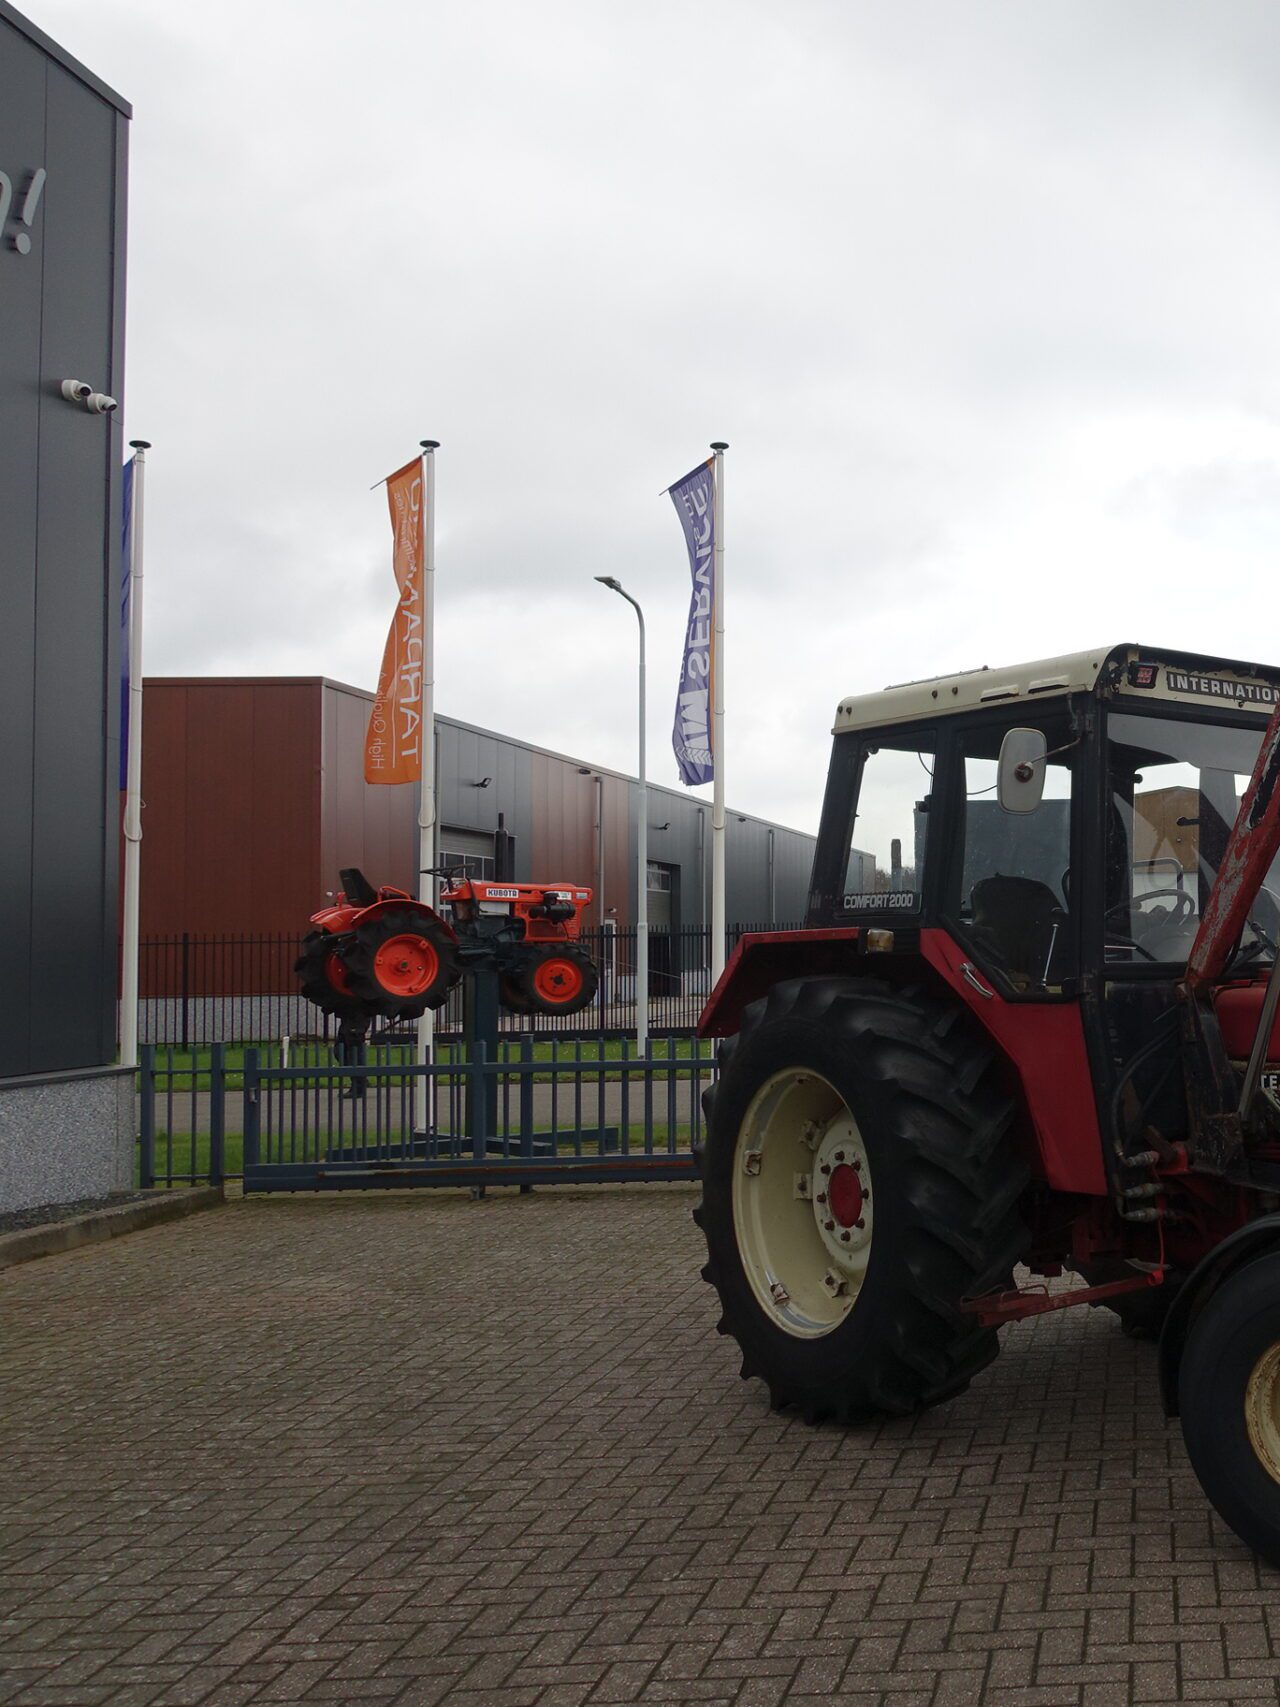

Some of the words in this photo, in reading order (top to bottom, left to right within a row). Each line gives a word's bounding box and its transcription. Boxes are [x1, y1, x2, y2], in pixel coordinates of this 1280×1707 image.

[487, 889, 517, 898] KUBOTA
[843, 894, 889, 909] COMFORT
[889, 893, 914, 908] 2000
